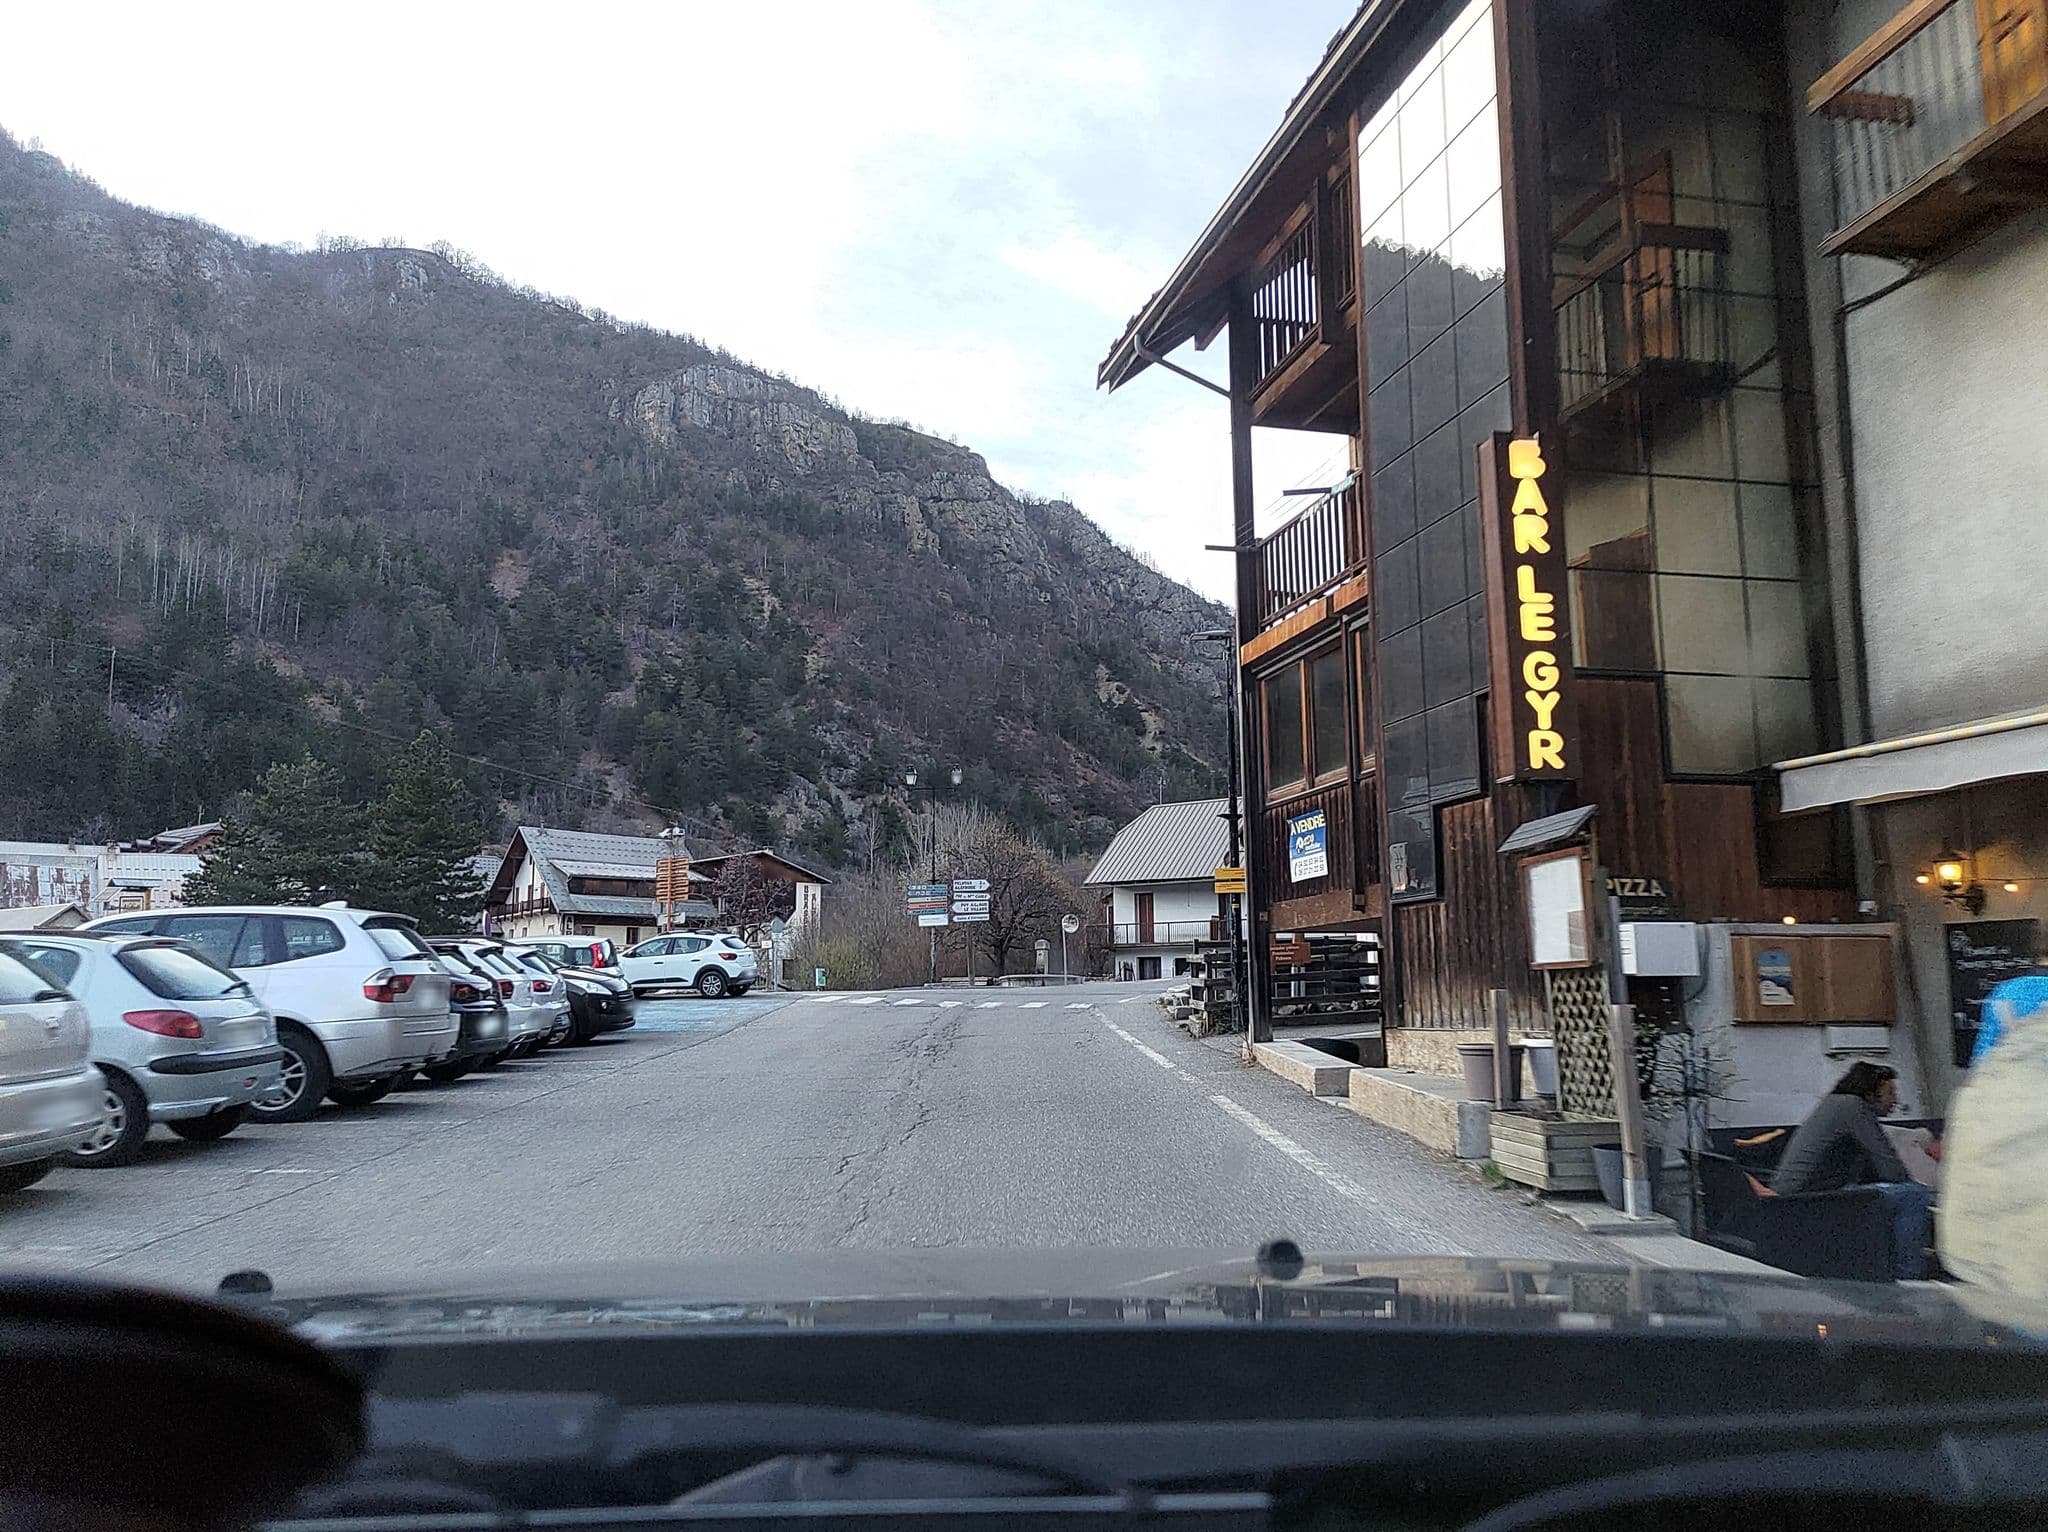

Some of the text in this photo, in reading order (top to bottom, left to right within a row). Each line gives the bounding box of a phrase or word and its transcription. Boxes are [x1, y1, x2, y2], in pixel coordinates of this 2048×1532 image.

[1508, 439, 1566, 770] BAR LE GYR
[1296, 814, 1326, 834] VENDRE
